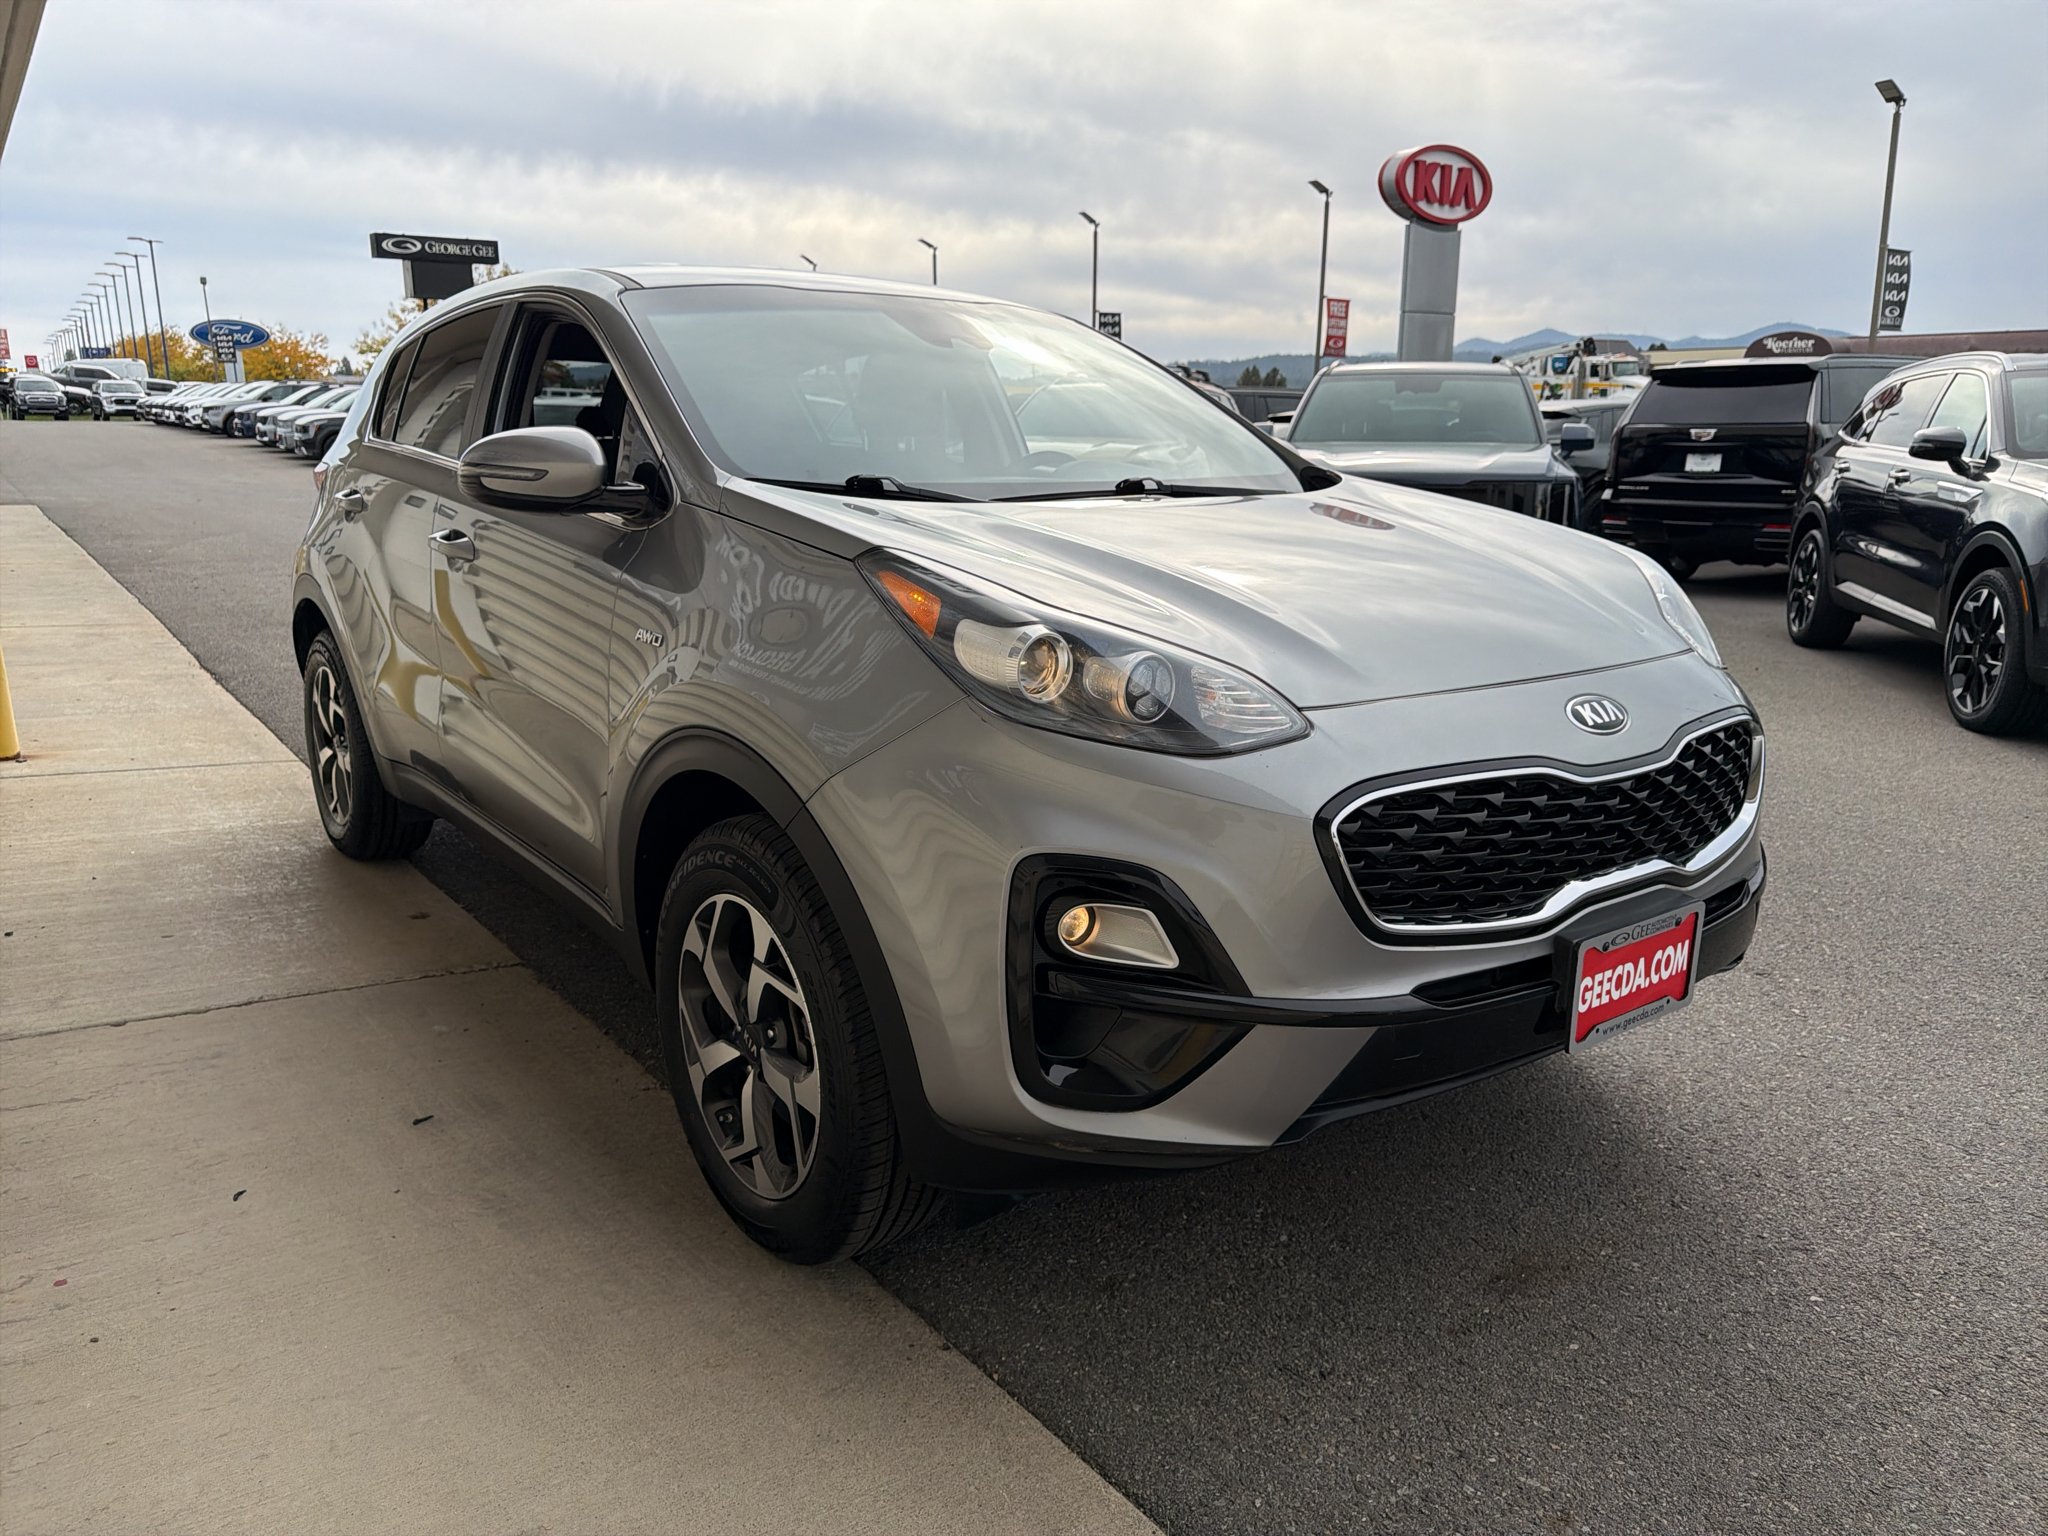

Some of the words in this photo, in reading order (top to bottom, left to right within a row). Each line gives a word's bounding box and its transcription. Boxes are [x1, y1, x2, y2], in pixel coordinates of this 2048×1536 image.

[1412, 160, 1476, 209] KIA
[424, 240, 472, 256] GEORGE
[472, 243, 495, 257] GEE
[1888, 254, 1909, 266] KIA
[1886, 272, 1908, 284] KIA
[1884, 289, 1906, 302] KIA
[208, 323, 254, 344] Frd
[1762, 336, 1815, 354] Koerner
[634, 628, 663, 647] AWD
[1574, 700, 1624, 726] KIA
[1631, 923, 1652, 940] GEE
[1578, 939, 1690, 1013] GEECDA.COM
[1602, 1004, 1665, 1036] www.geecda.com
